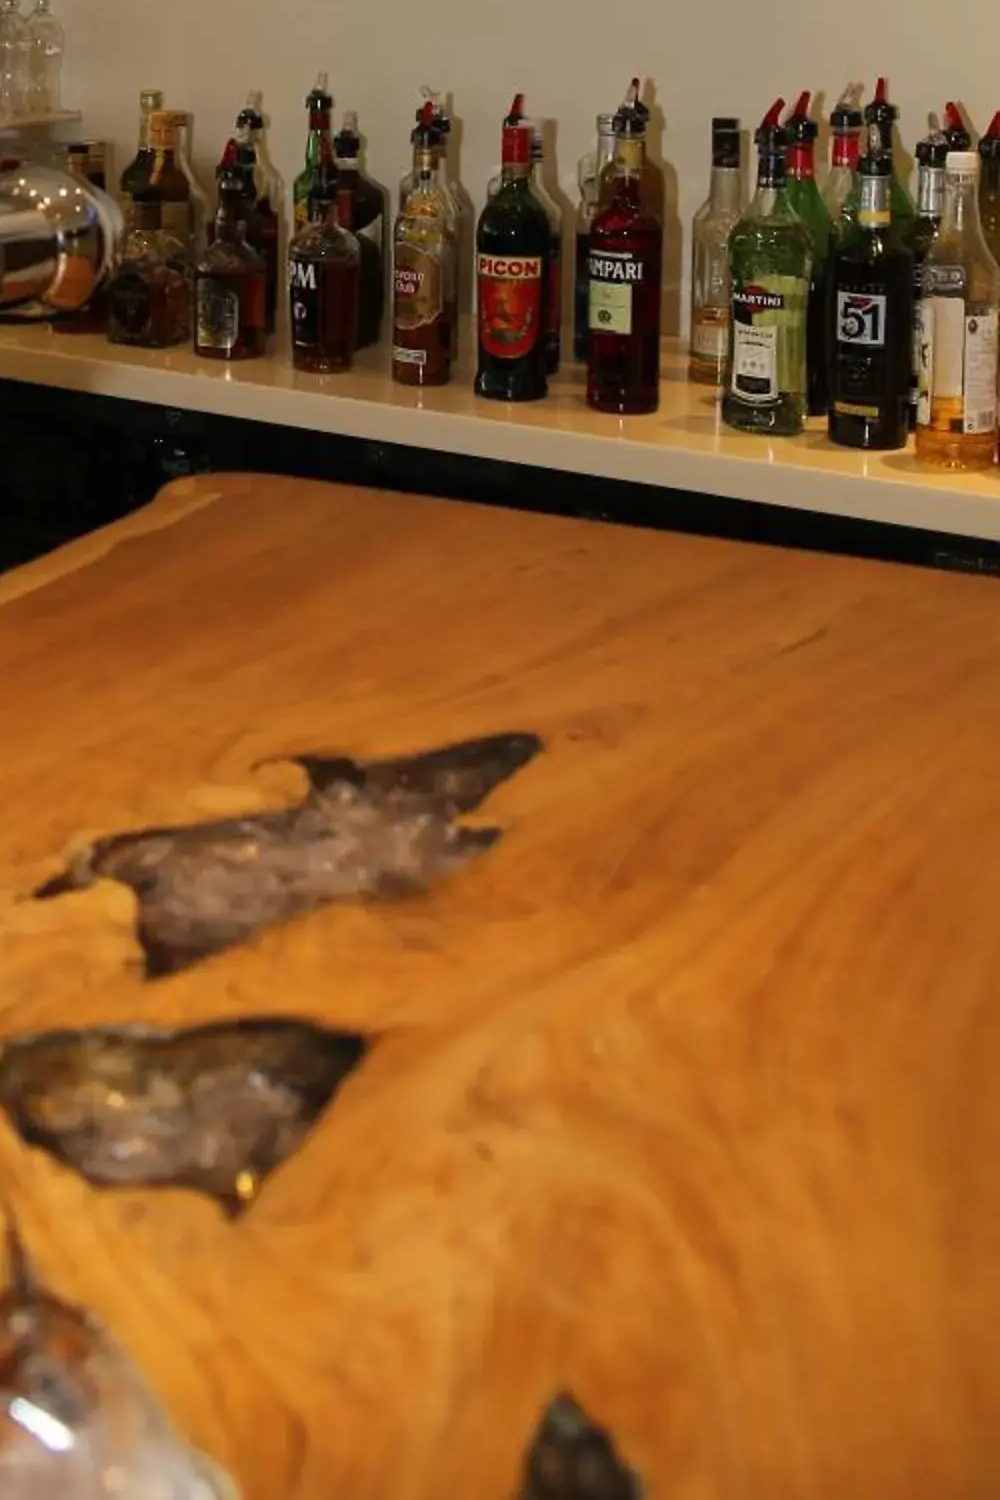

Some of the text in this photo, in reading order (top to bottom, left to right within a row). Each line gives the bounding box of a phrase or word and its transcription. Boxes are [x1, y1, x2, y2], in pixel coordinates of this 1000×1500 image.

[479, 258, 538, 276] PICON
[588, 257, 643, 280] MPARI
[732, 291, 781, 307] MARTINI
[841, 301, 879, 341] 51
